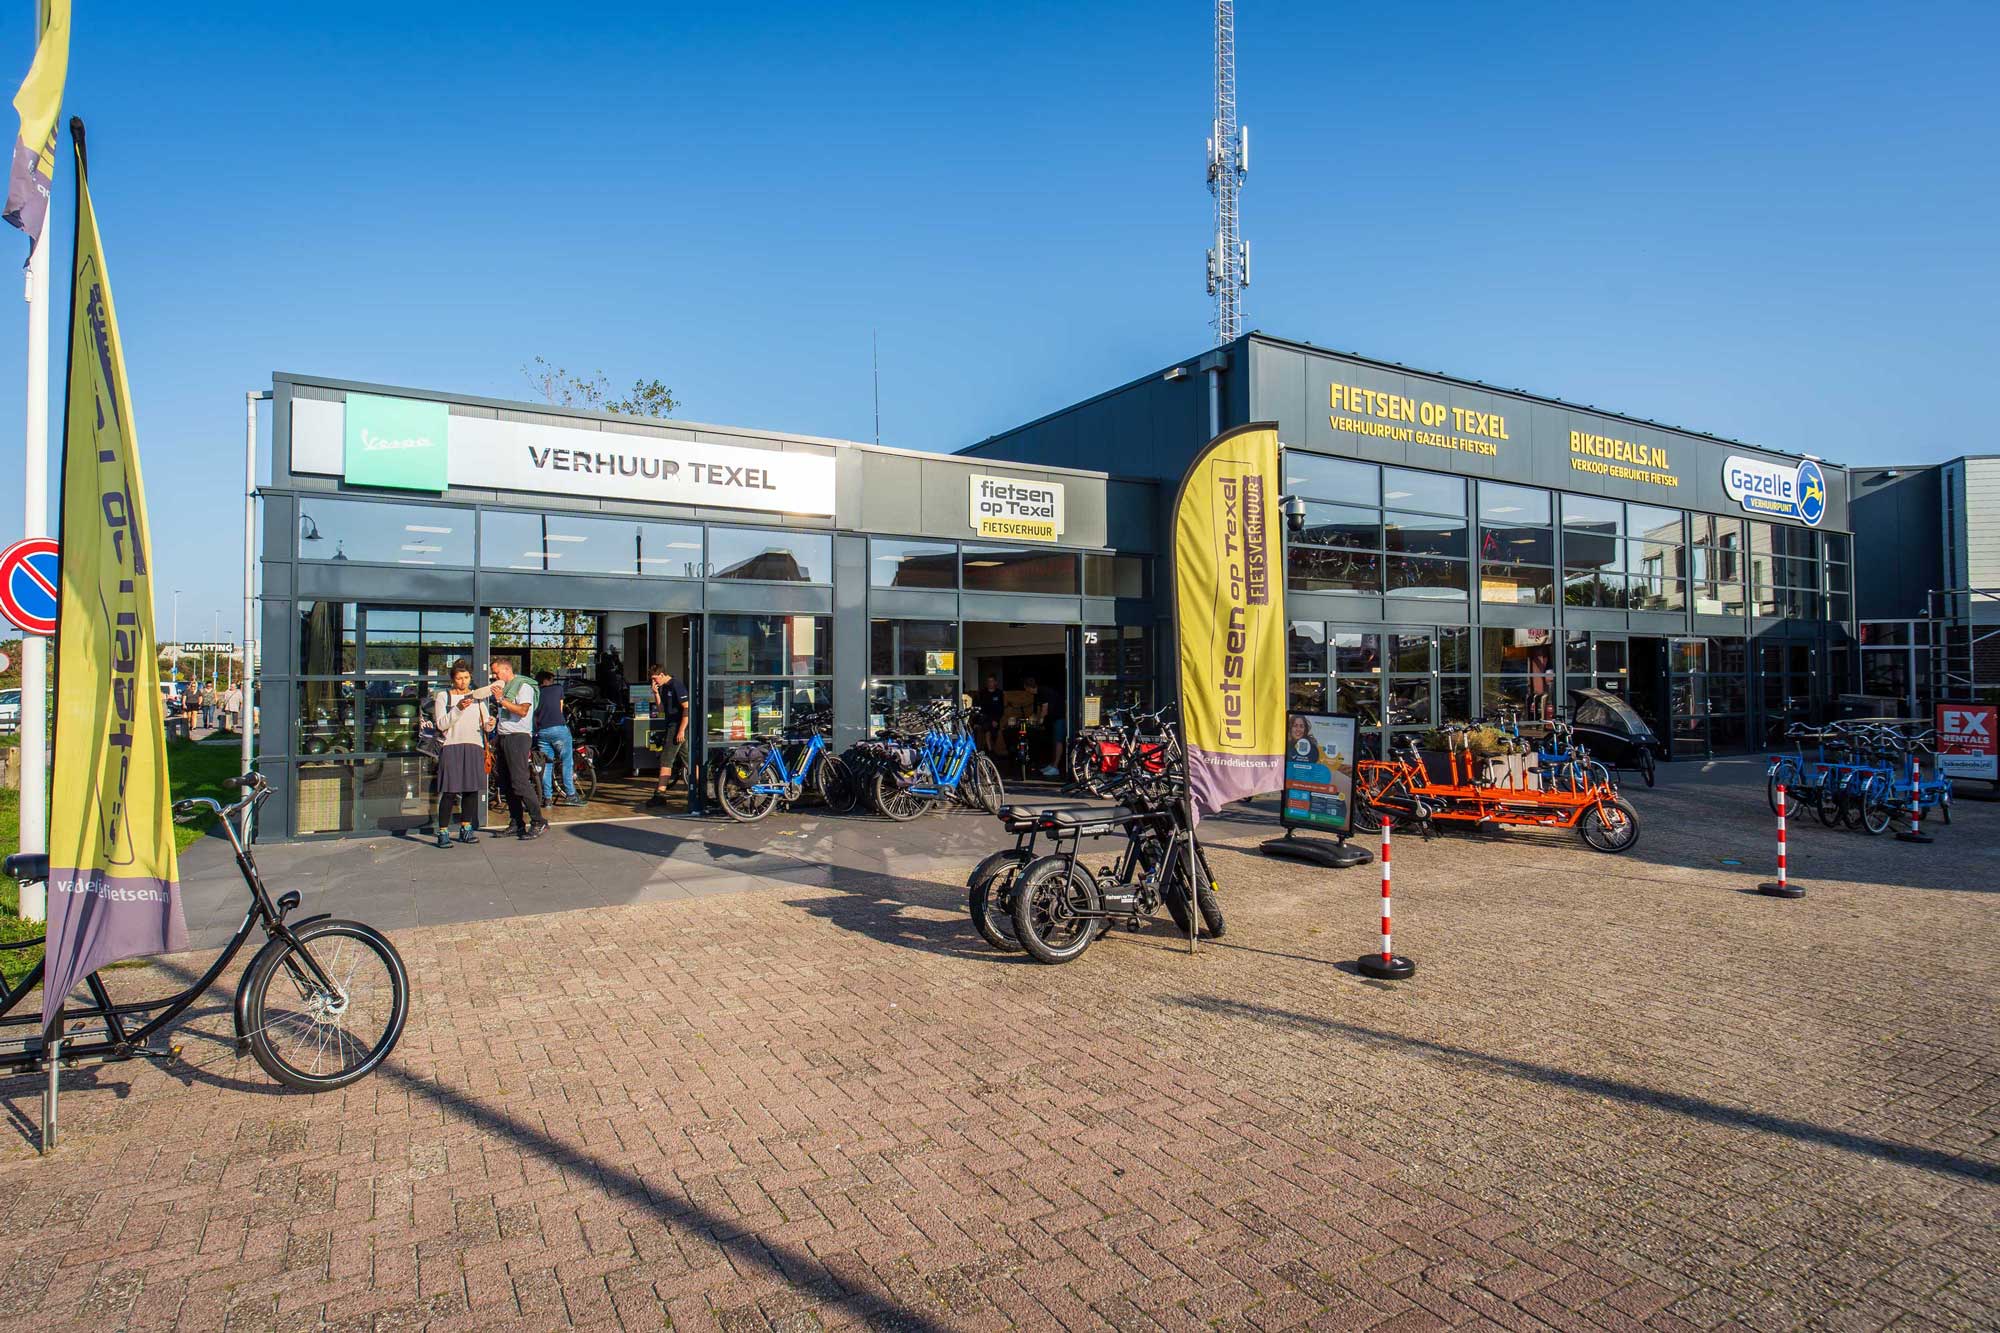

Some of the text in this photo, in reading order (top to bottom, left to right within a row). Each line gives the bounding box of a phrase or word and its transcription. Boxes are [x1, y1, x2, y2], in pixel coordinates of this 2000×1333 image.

[1329, 383, 1509, 440] FIETSEN OP TEXEL
[1329, 415, 1497, 456] VERHUURPUNT GAZELLE FIETSEN
[1570, 430, 1669, 469] BIKEDEALS.NL
[528, 445, 777, 491] VERHUUR TEXEL
[1571, 458, 1678, 487] VERKOOP GEBRUIKTE FIETSEN
[981, 480, 1054, 504] fietsen
[1731, 469, 1791, 498] Gazelle
[980, 501, 1054, 518] op Texel
[1219, 477, 1238, 557] Texel
[1751, 497, 1793, 513] VERHUURPUNT
[983, 521, 1053, 536] FIETSVERHUUR
[1249, 481, 1265, 598] FIETSVERHUUR
[1230, 563, 1244, 600] op
[186, 643, 233, 652] KARTING
[1084, 632, 1098, 644] 75
[1943, 710, 1990, 735] EX
[1943, 734, 1990, 744] RENTALS
